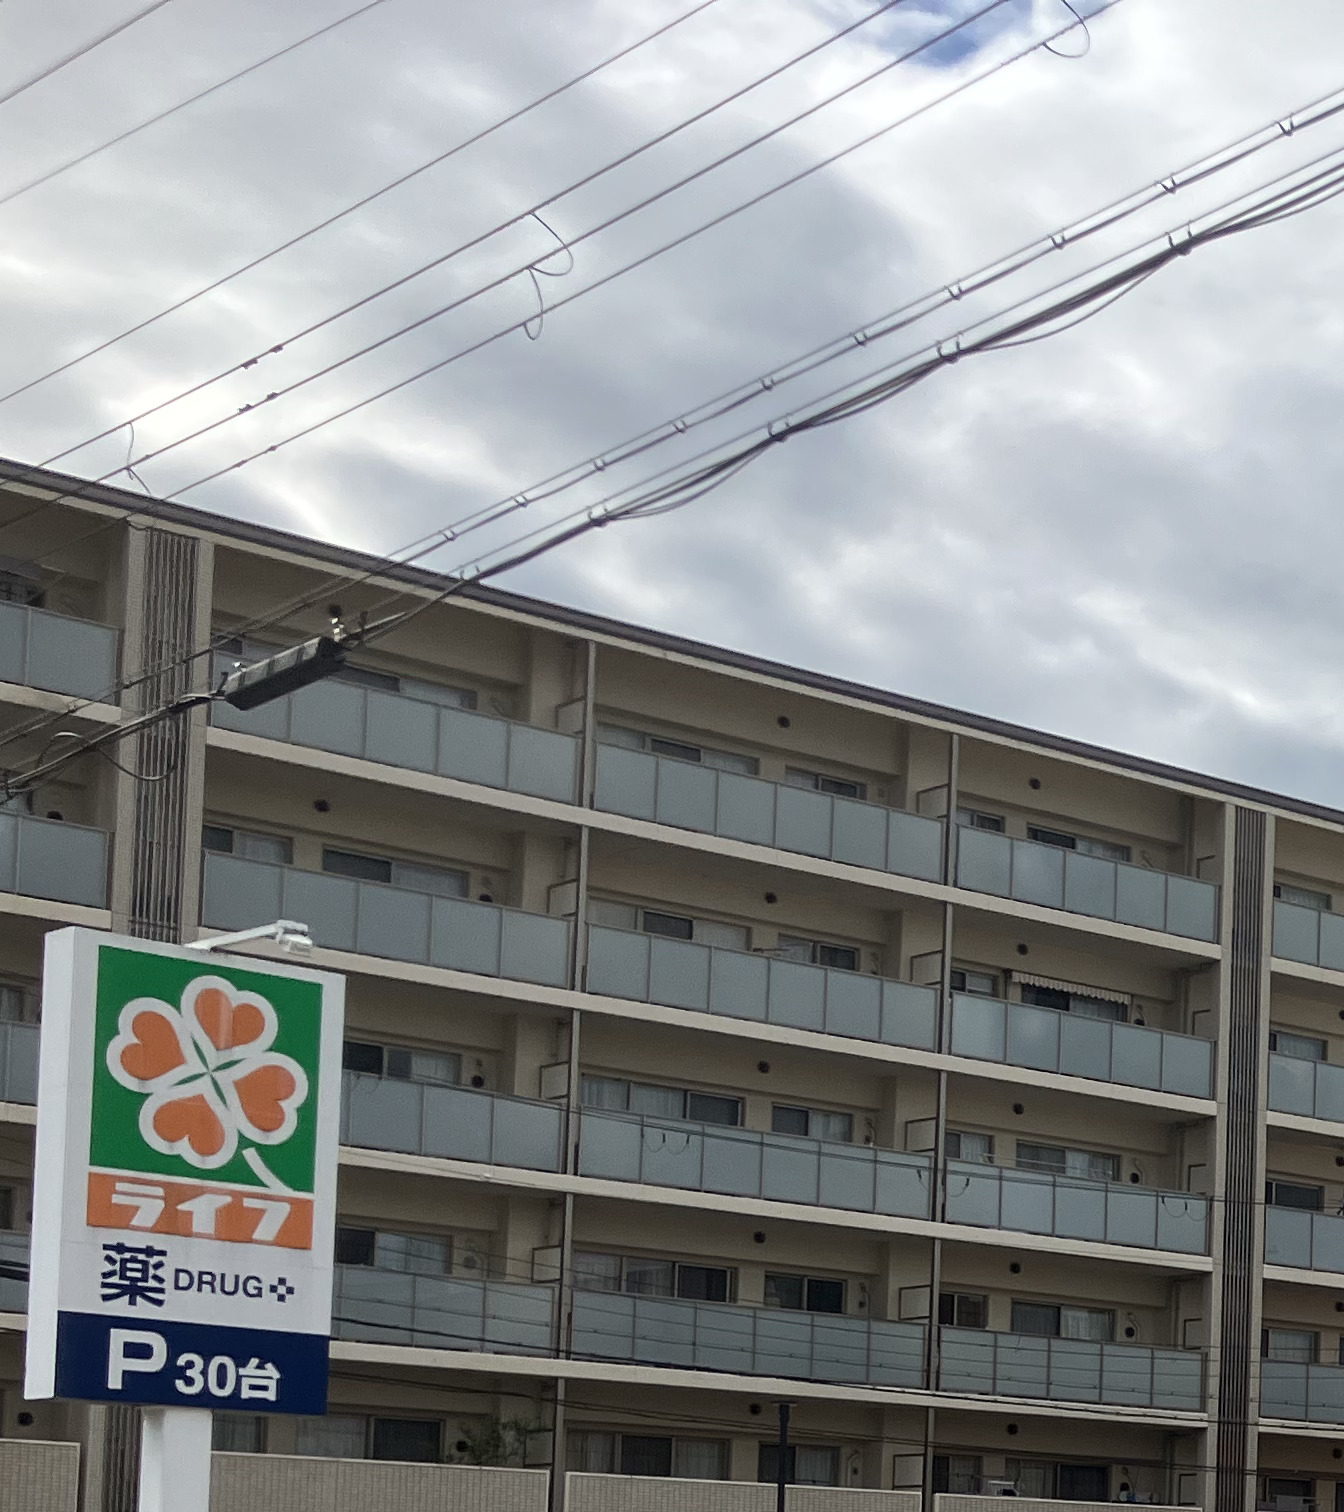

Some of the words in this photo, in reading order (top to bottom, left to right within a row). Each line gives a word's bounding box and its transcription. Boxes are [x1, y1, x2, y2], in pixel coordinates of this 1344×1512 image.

[110, 1182, 292, 1241] ライフ
[99, 1242, 167, 1309] 薬
[173, 1267, 265, 1301] DRUG
[107, 1329, 168, 1391] P
[174, 1352, 282, 1403] 30台
